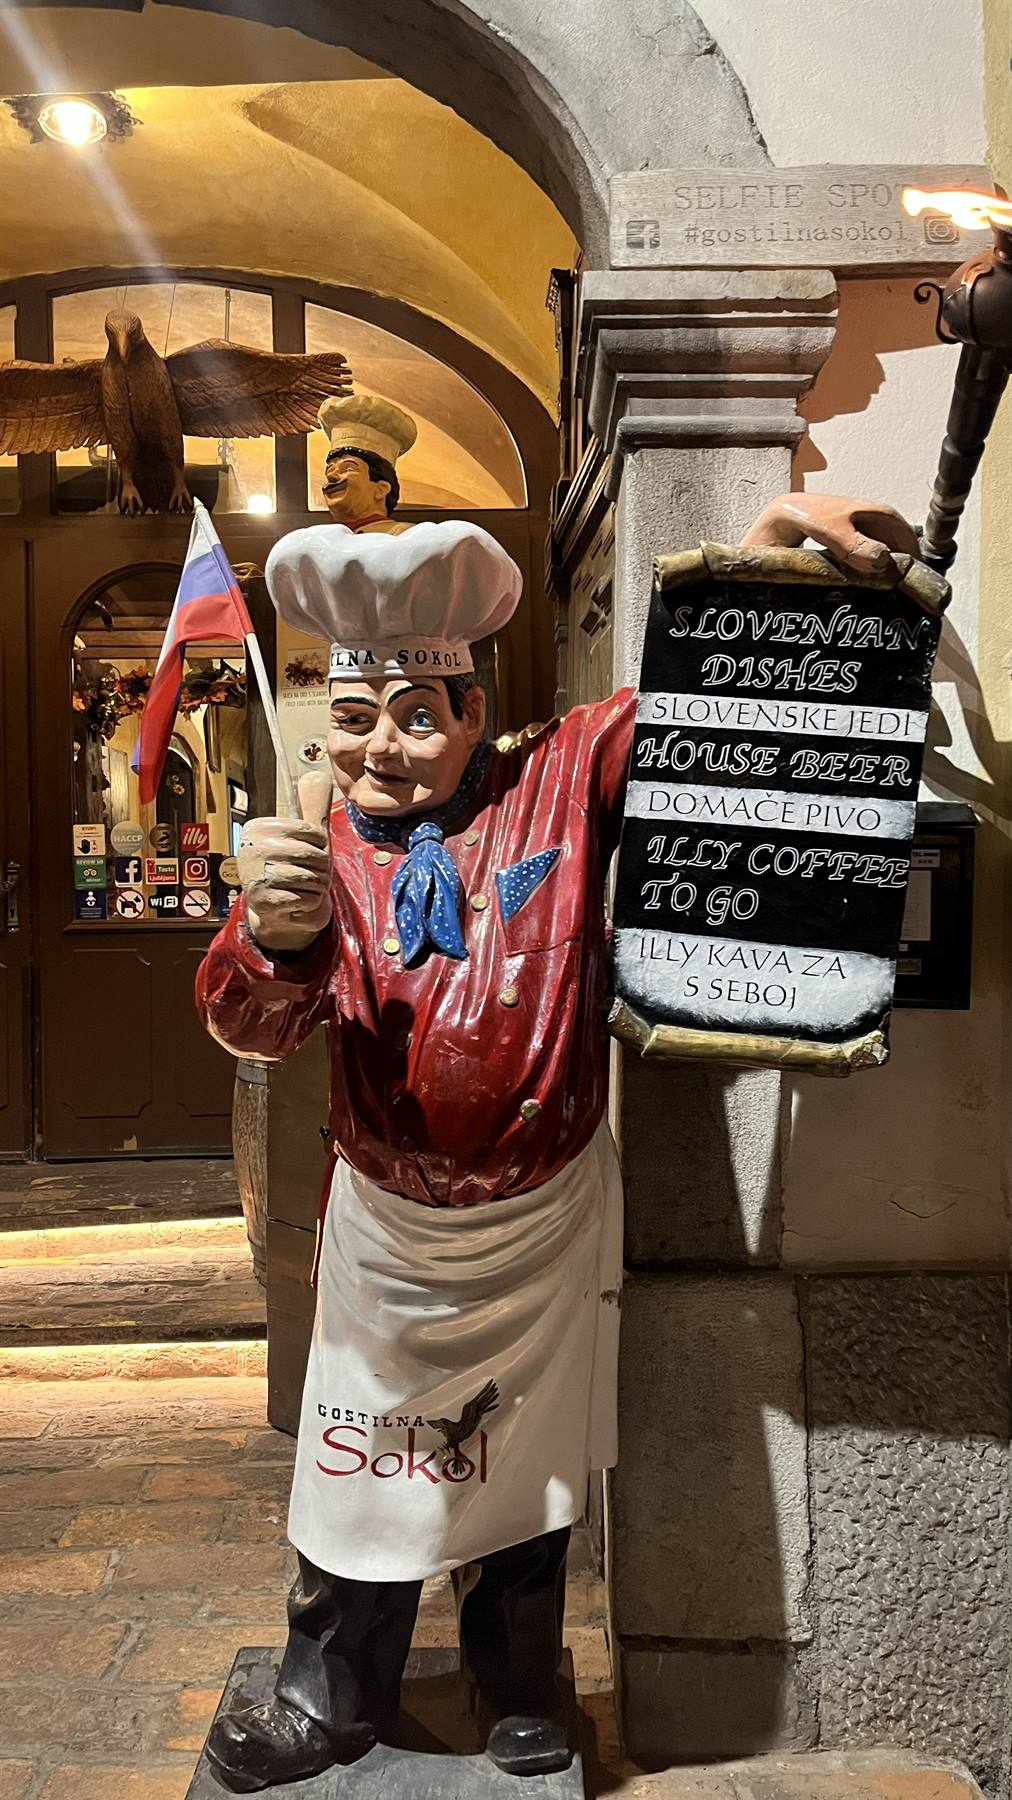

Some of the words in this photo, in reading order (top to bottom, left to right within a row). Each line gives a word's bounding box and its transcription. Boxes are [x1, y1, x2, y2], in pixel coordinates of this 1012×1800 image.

[674, 184, 804, 210] SELFIE
[684, 220, 908, 247] #gostilnasokol
[669, 605, 930, 650] SLOVENIAN
[397, 650, 461, 667] SOKOL
[701, 650, 862, 693] DISHES
[652, 697, 838, 731] SLOVENSKE
[846, 712, 910, 737] JEDI
[637, 731, 780, 776] HOUSE
[790, 750, 912, 786] BEER
[648, 790, 796, 823] DOMAČE
[806, 803, 881, 831] PIVO
[113, 834, 143, 842] HACCP
[183, 827, 208, 849] illy
[647, 835, 741, 869] ILLY
[748, 843, 910, 888] COFFEE
[641, 873, 697, 911] TO
[706, 886, 759, 926] GO
[640, 937, 698, 968] ILLY
[708, 944, 793, 974] KAVA
[801, 954, 848, 979] ZA
[683, 976, 699, 997] S
[707, 978, 797, 1012] SEBOJ
[317, 1403, 425, 1428] GOSTILNA
[316, 1425, 488, 1485] Sokol
